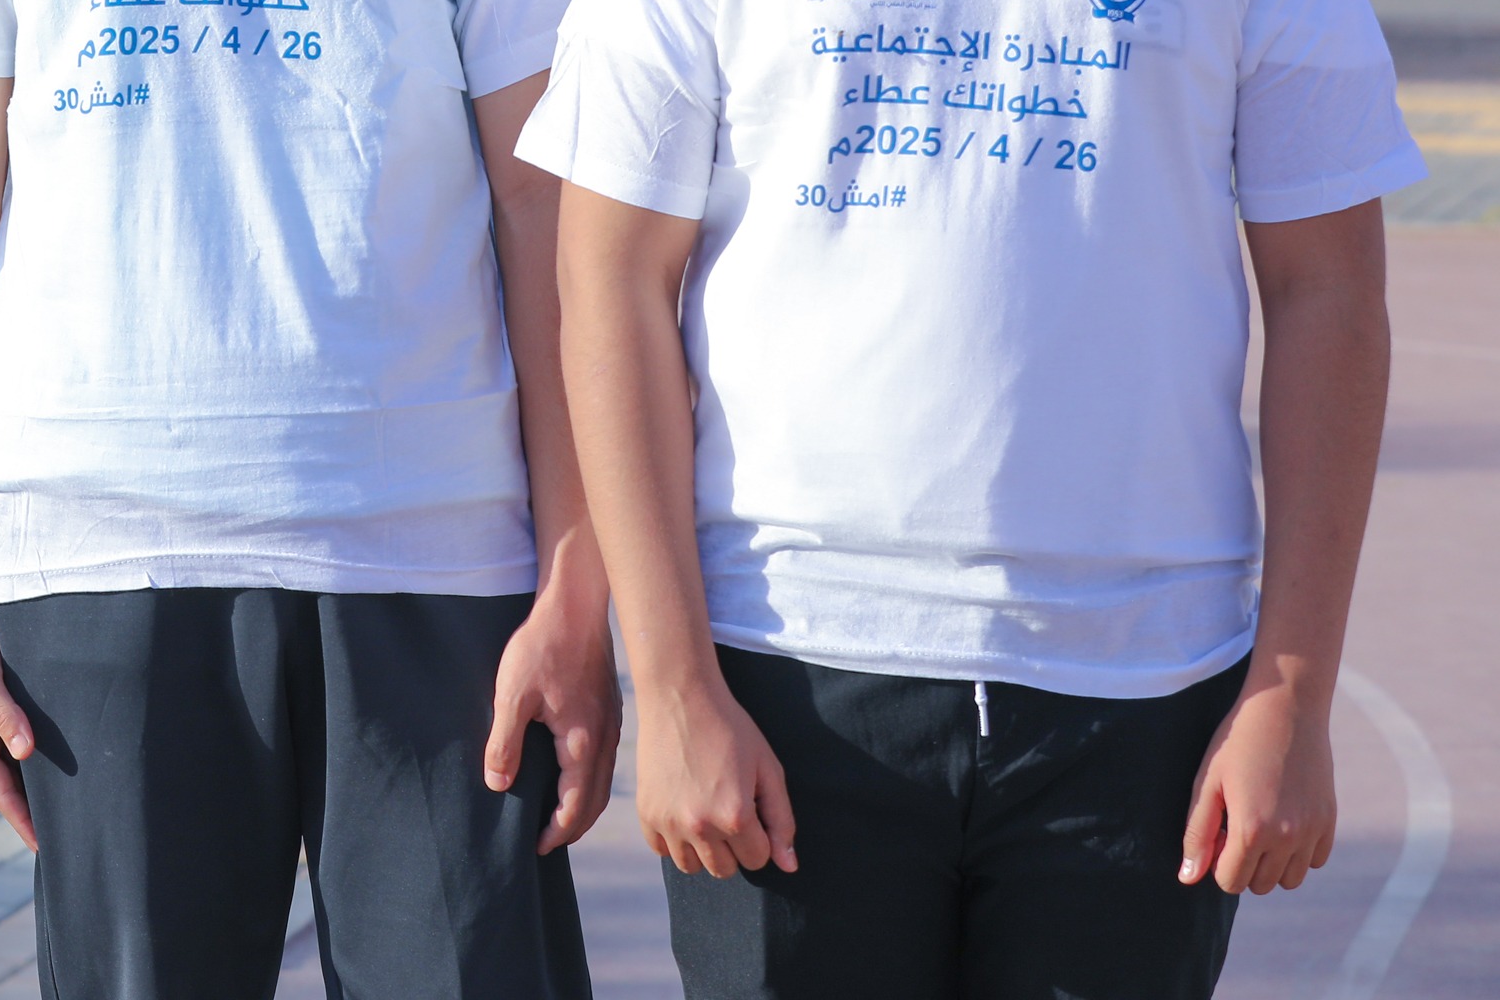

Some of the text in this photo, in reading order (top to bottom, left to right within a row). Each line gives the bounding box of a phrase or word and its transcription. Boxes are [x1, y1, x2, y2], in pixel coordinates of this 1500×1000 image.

[192, 26, 210, 52] /
[222, 27, 241, 54] 4
[253, 30, 270, 55] /
[282, 31, 322, 60] 26
[811, 24, 1131, 75] المبادرة الإجتماعية
[842, 74, 1088, 122] خطواتك عطاء
[955, 132, 976, 159] /
[988, 134, 1010, 163] 4
[1024, 138, 1043, 166] /
[1054, 139, 1097, 172] 26
